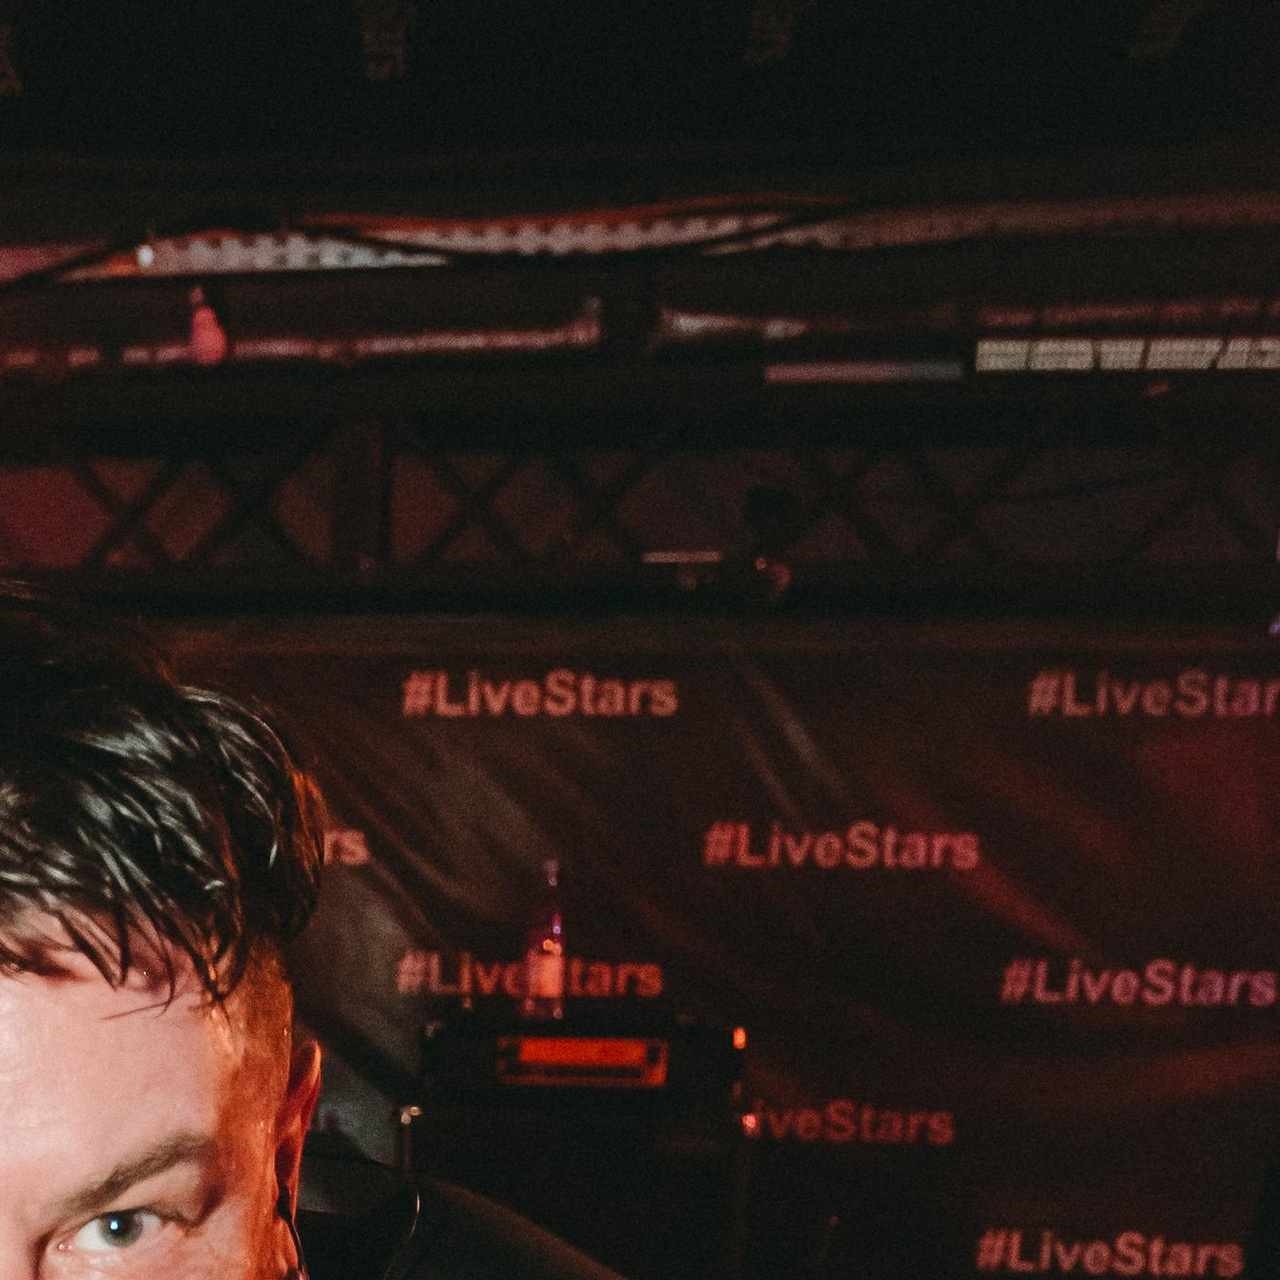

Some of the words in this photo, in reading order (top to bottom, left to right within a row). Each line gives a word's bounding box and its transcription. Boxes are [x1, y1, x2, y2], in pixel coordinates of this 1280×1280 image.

[402, 669, 680, 718] #LiveStars
[1027, 668, 1280, 717] #LiveStar
[702, 820, 981, 869] #LiveStars
[396, 950, 664, 998] #Livetars
[1000, 958, 1279, 1006] #LiveStars
[742, 1098, 955, 1147] iveStars
[975, 1227, 1244, 1280] #LiveStars
